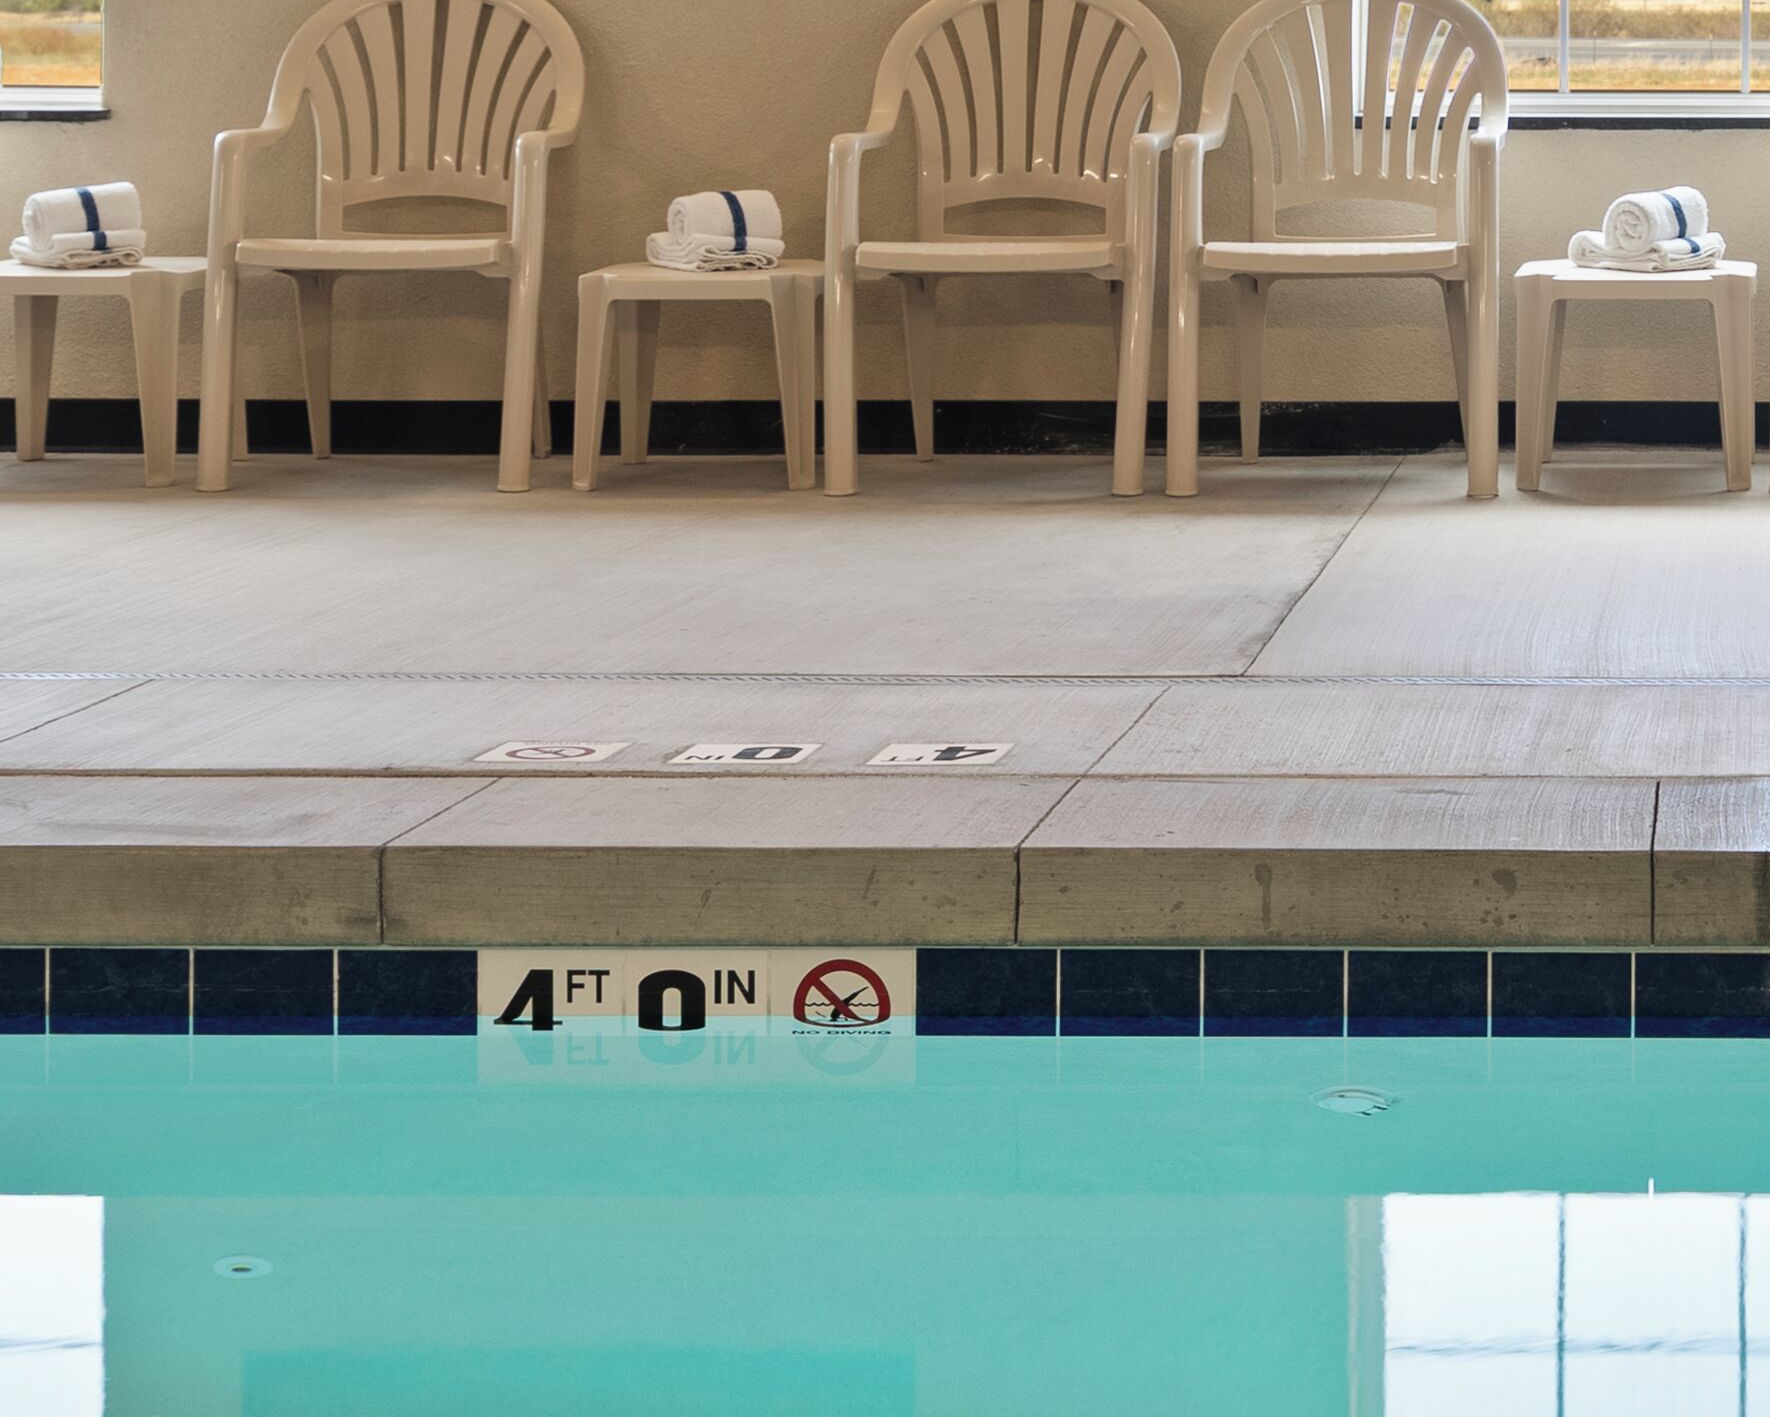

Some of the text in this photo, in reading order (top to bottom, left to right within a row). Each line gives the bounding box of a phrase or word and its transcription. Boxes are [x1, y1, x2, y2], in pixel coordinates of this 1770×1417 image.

[732, 746, 804, 760] 0
[933, 746, 997, 761] 4
[493, 969, 755, 1031] 4 FT 0 IN
